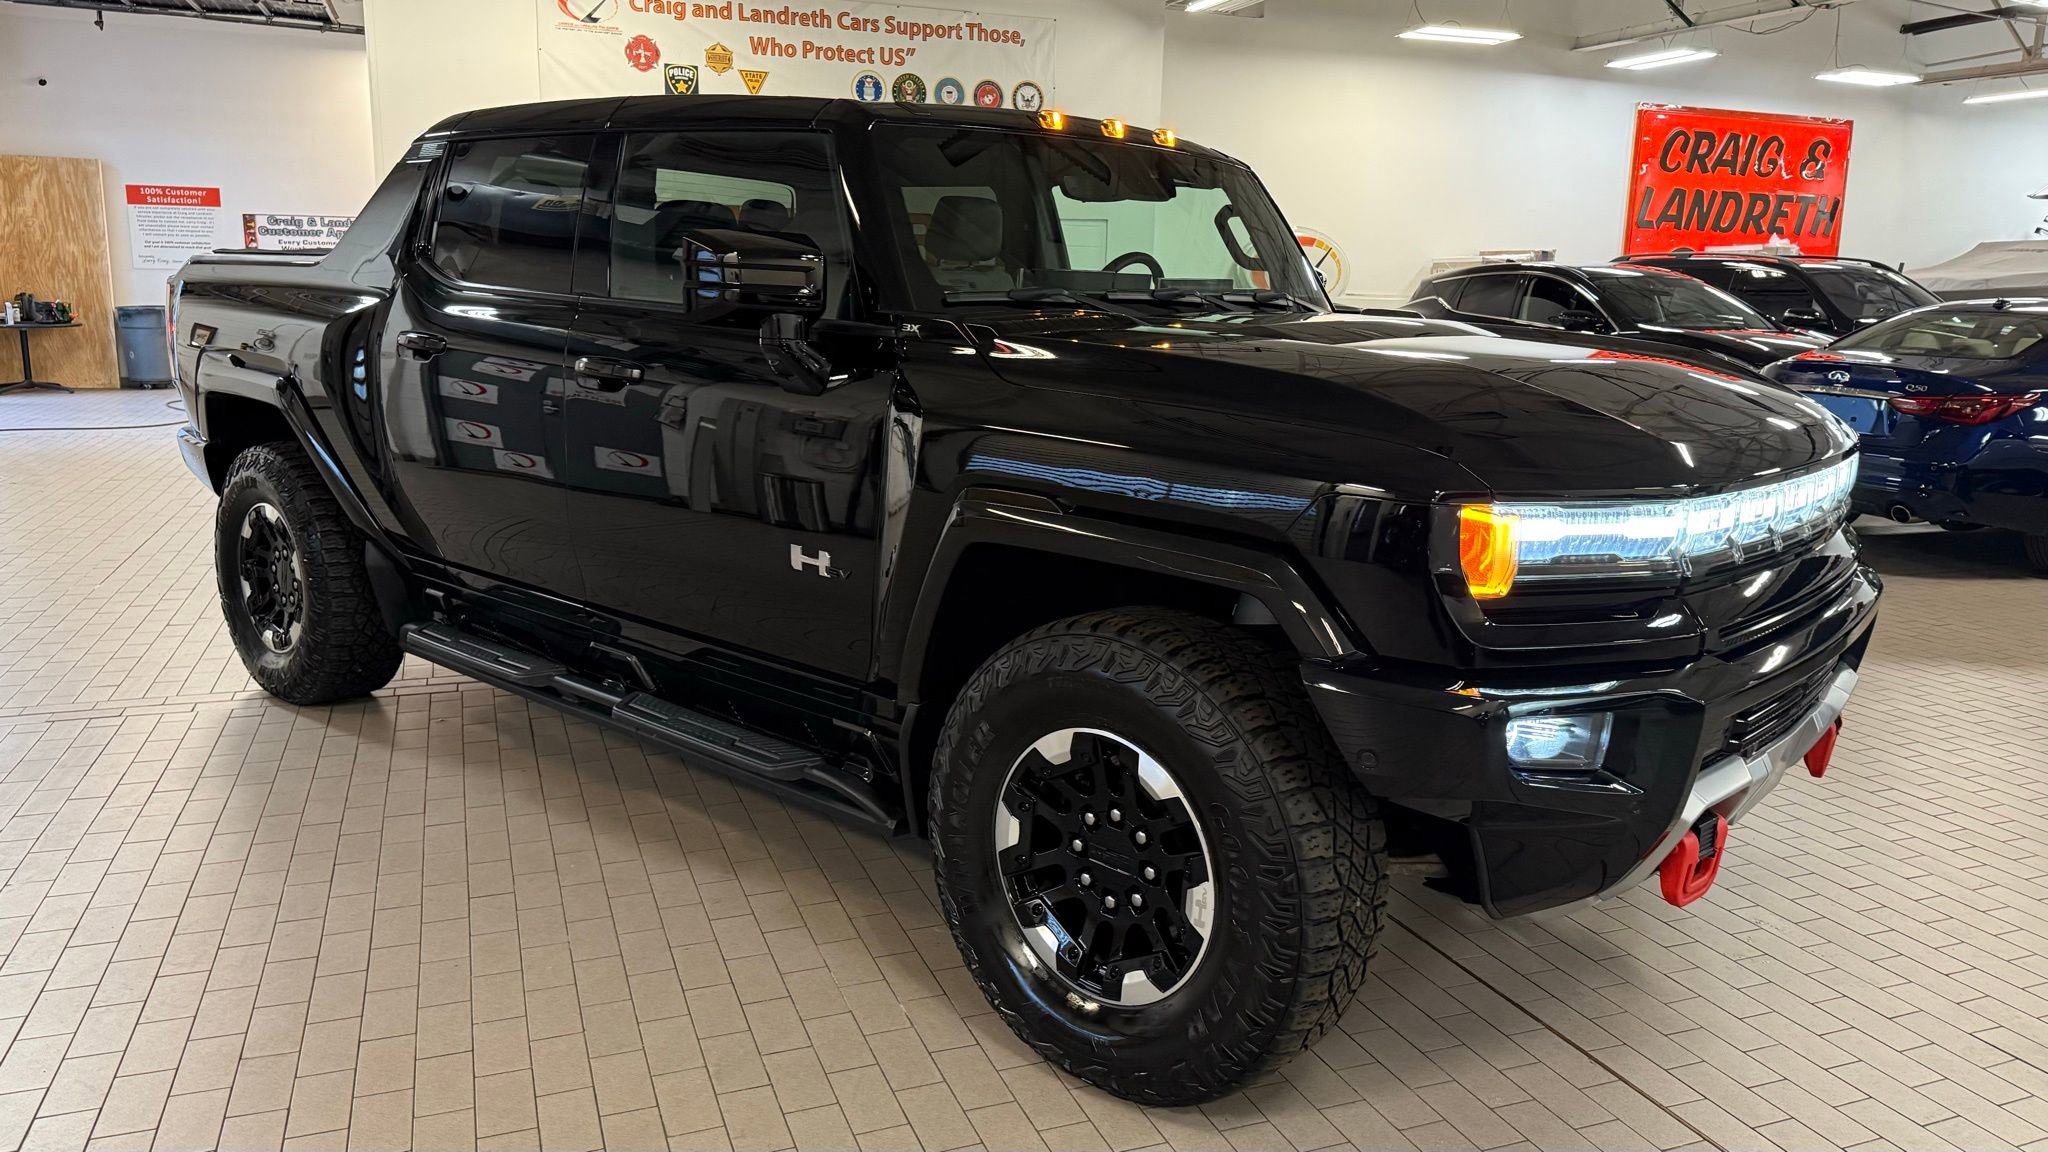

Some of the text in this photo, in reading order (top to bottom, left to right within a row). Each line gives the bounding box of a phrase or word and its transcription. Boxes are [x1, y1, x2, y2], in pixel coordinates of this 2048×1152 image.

[628, 0, 1026, 47] Craig and Landreth Cars Support Those,
[748, 36, 797, 58] Who
[802, 41, 875, 65] Protect
[668, 67, 695, 79] POLICE
[744, 72, 763, 80] STATE
[1659, 129, 1832, 181] CRAIG &
[140, 187, 207, 197] 100% Customer
[146, 196, 201, 205] Satisfaction!
[1636, 187, 1841, 239] LANDRETH
[267, 216, 304, 229] Craig
[307, 217, 317, 227] &
[258, 226, 323, 237] Customer
[1905, 384, 1928, 392] Q50
